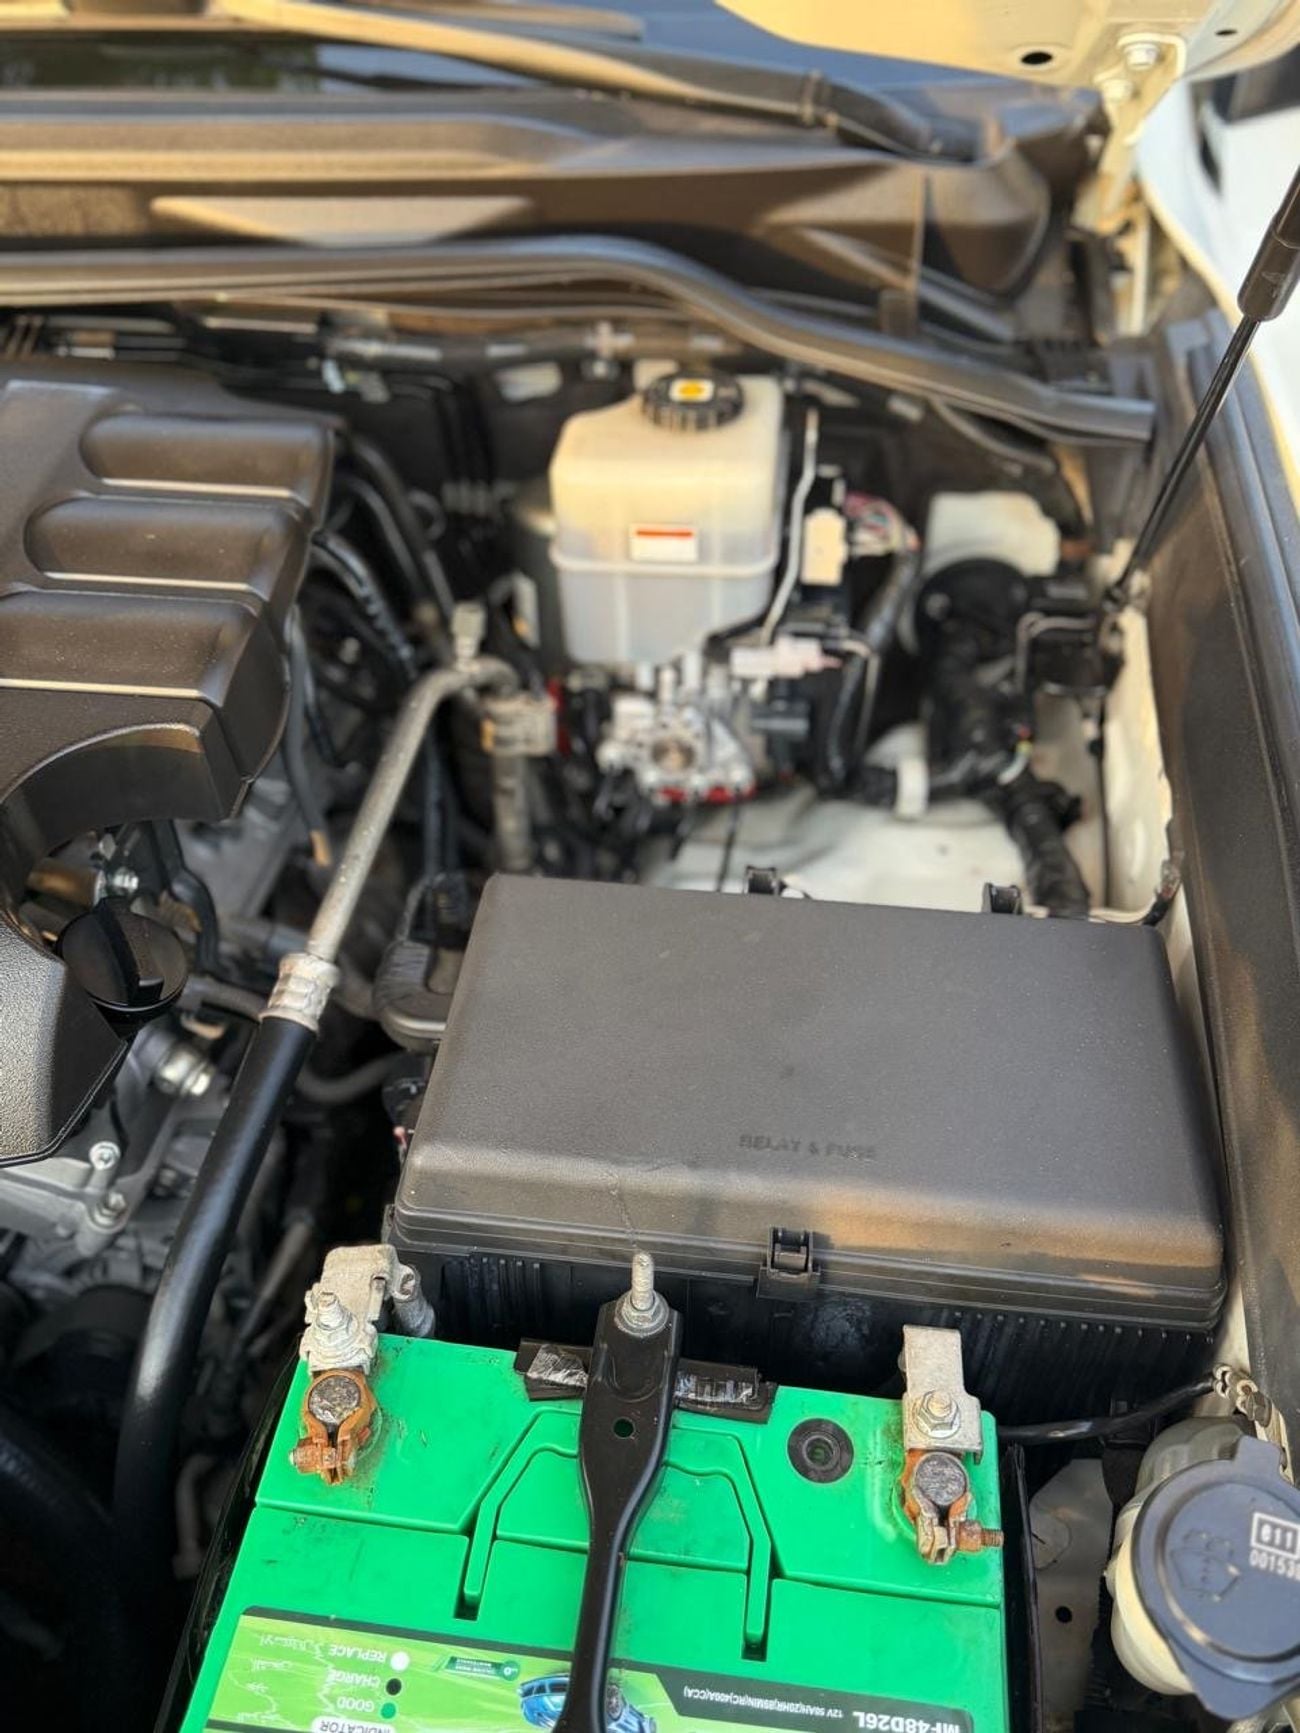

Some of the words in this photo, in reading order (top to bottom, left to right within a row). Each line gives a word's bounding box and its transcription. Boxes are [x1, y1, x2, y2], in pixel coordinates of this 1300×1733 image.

[739, 1134, 801, 1152] RELAY
[808, 1141, 819, 1154] &
[826, 1143, 877, 1160] FUSE
[328, 1643, 387, 1663] REPLACE
[327, 1669, 381, 1688] CHARGE
[336, 1696, 375, 1712] GOOD
[826, 1708, 844, 1718] 12V
[852, 1711, 960, 1733] MF48D26L
